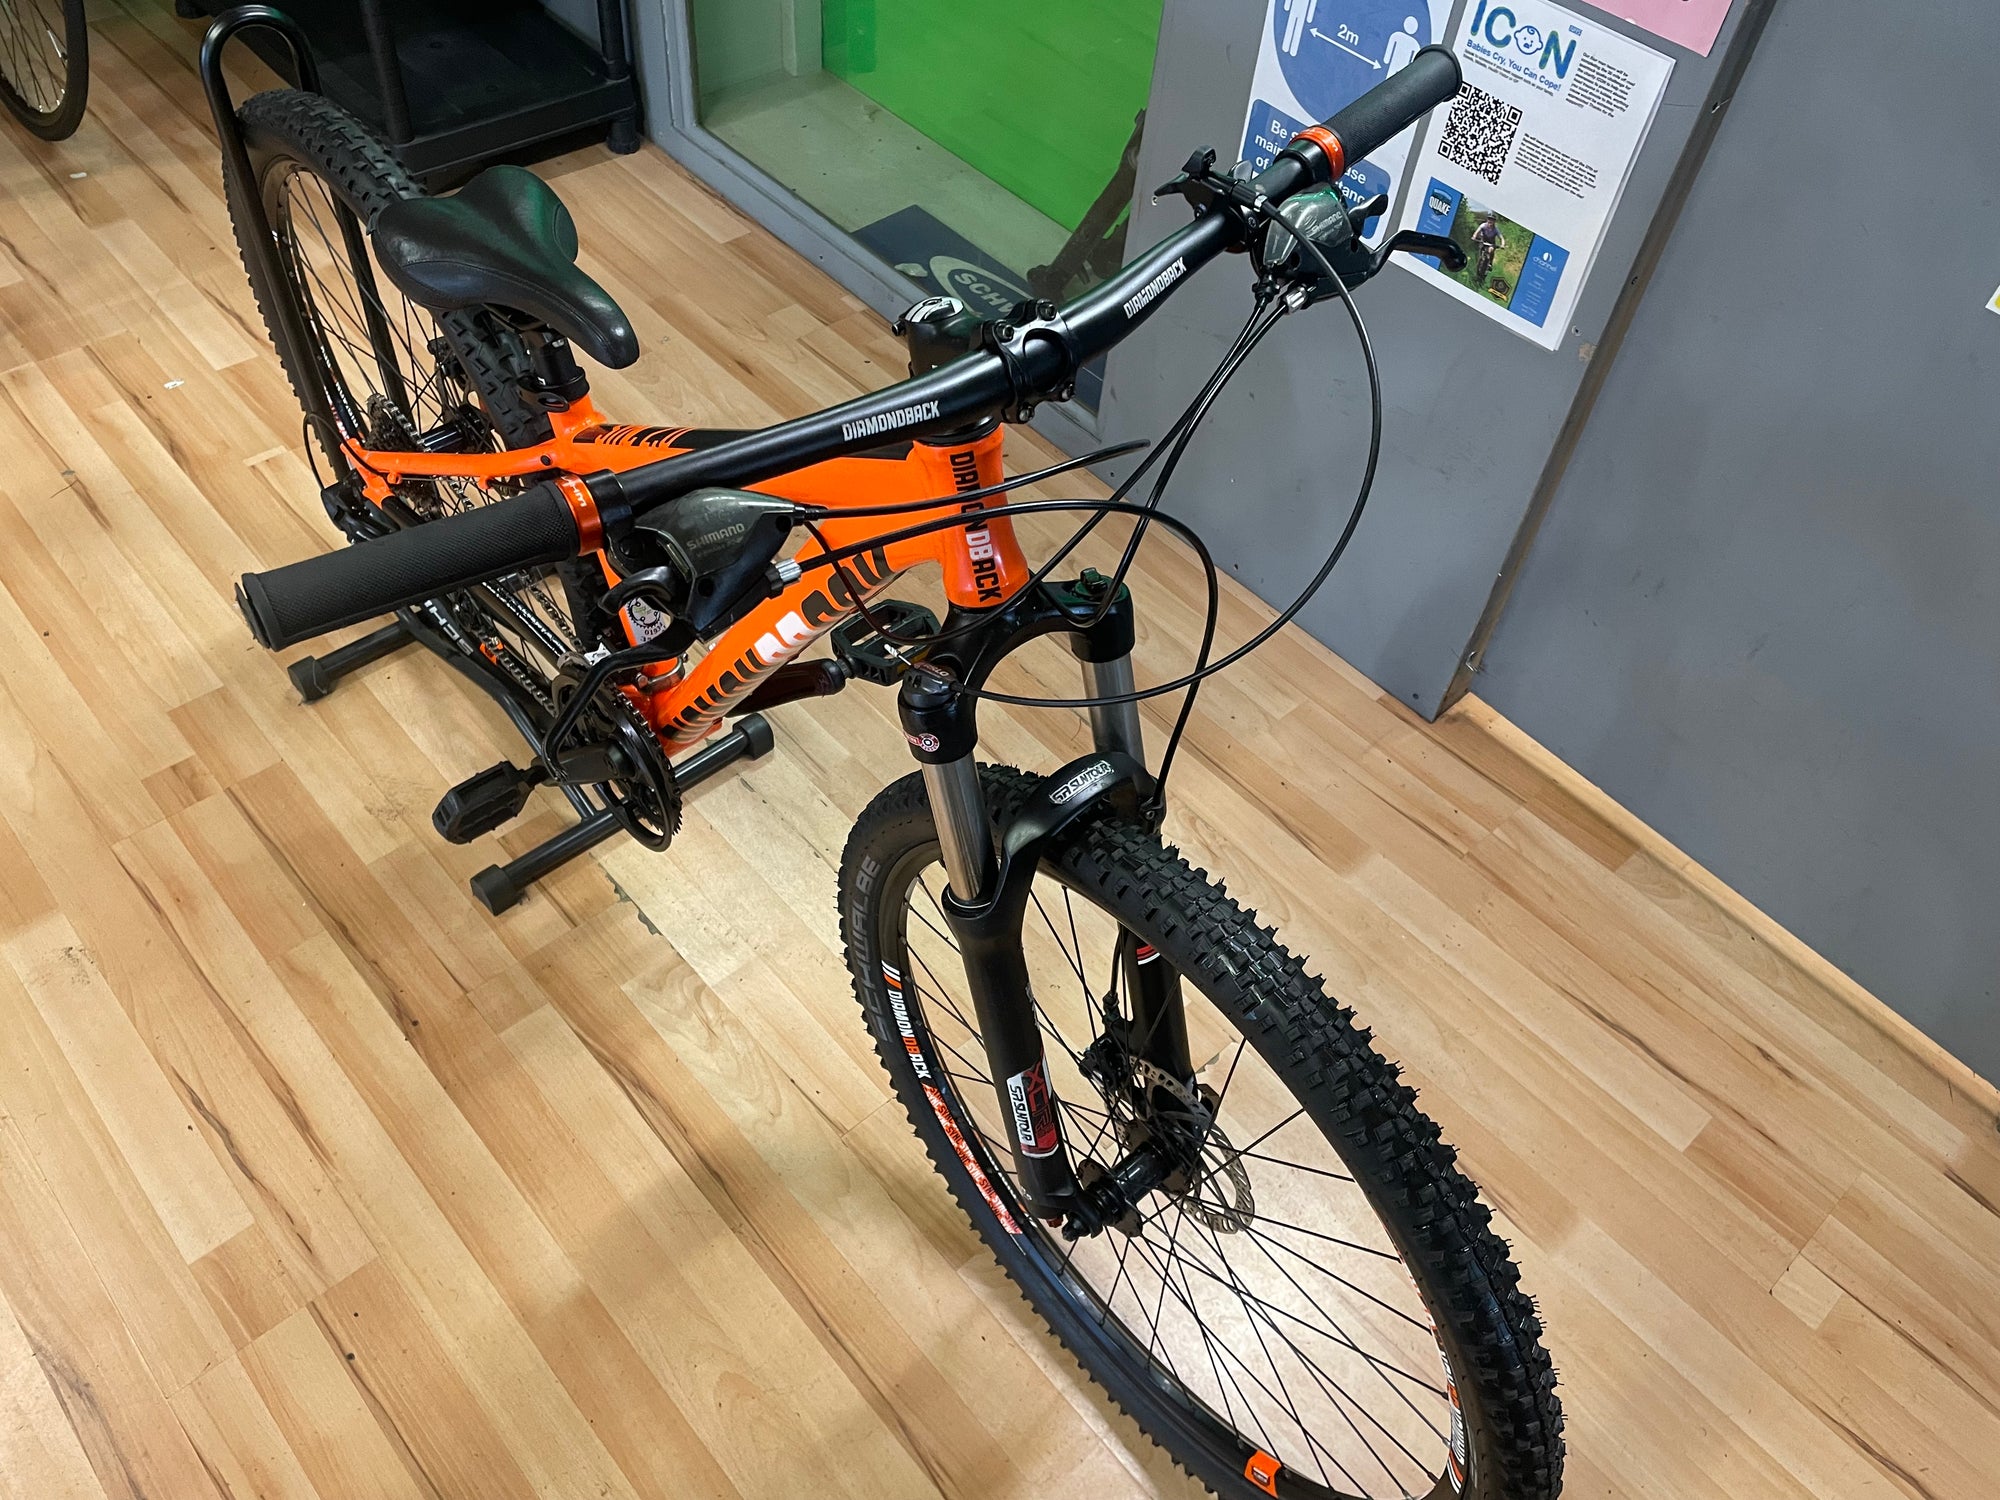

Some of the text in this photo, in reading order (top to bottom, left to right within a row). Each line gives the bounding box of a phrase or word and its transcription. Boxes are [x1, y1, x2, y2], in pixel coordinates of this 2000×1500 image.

[1337, 23, 1360, 46] 2m
[1466, 39, 1491, 57] Babies
[1492, 52, 1507, 66] Cry,
[1508, 56, 1522, 72] You
[1523, 67, 1538, 81] Can
[1539, 75, 1562, 92] Cope!
[1270, 119, 1288, 139] Be
[1255, 156, 1270, 171] of
[1429, 195, 1451, 217] QUAKE
[1123, 256, 1187, 319] DIAMONDBACK
[841, 400, 940, 441] DIAMONDBACK
[686, 523, 745, 550] SHIMANO
[888, 989, 931, 1079] DIAMONDBACK
